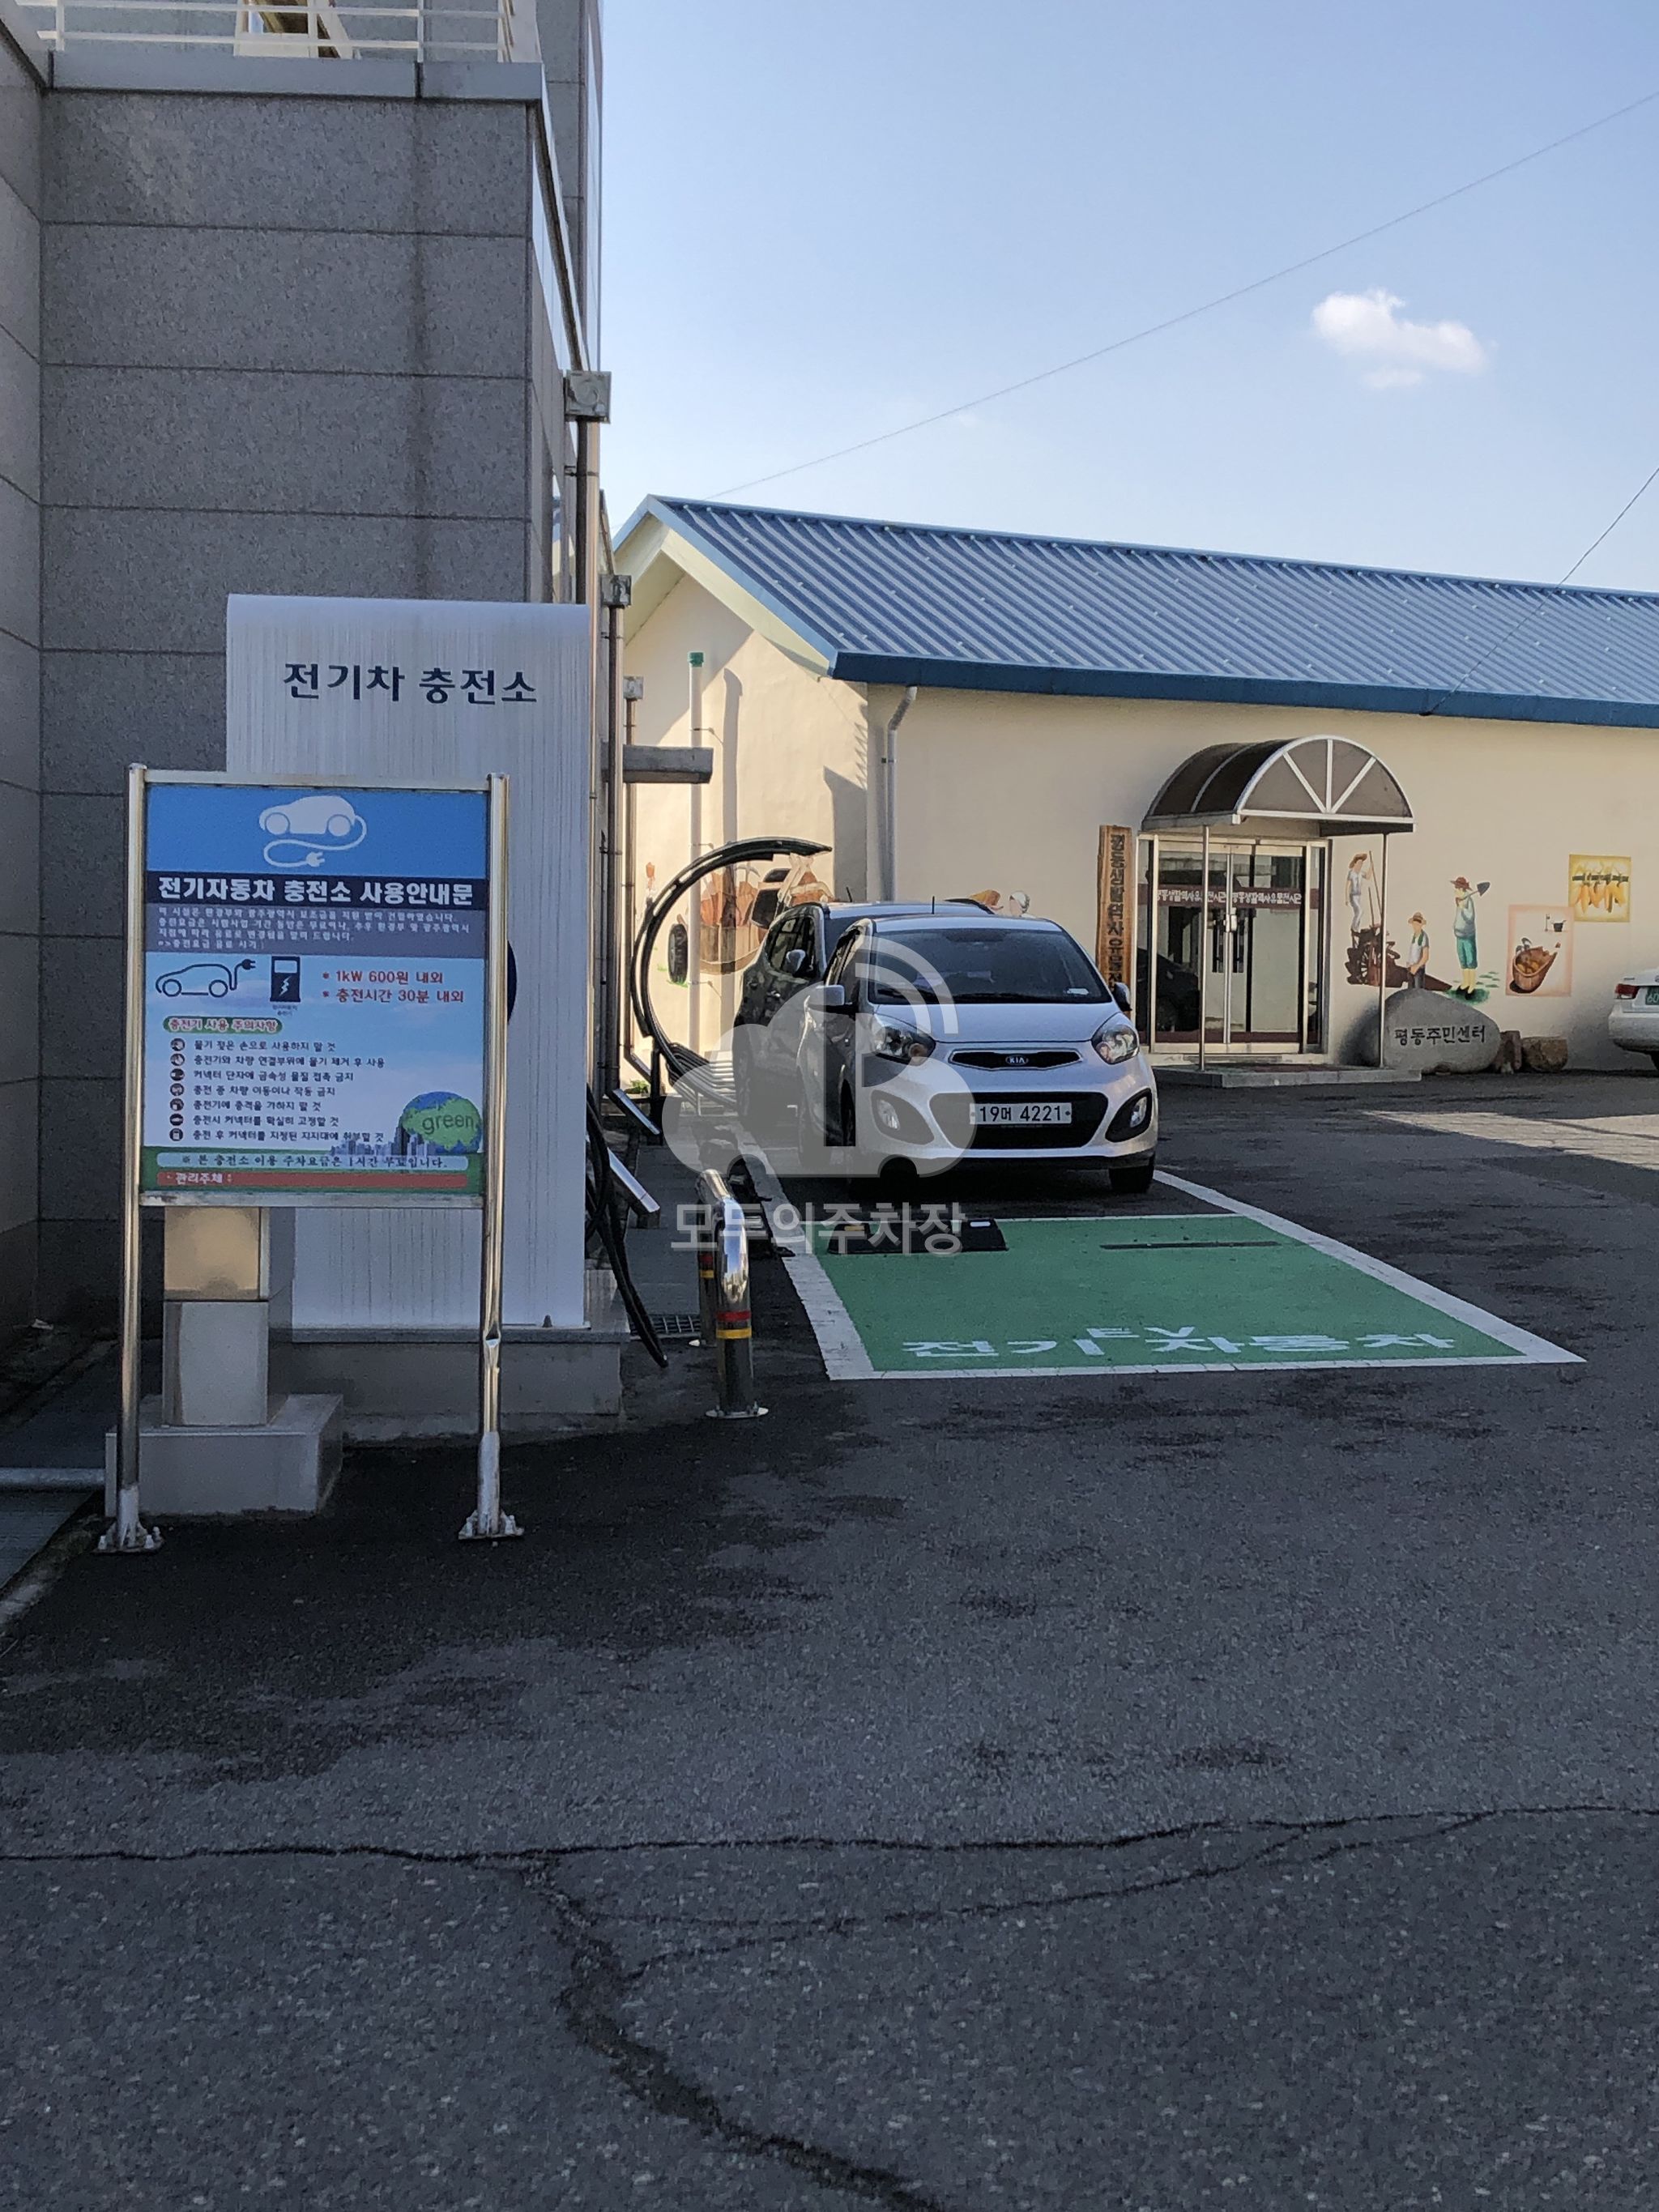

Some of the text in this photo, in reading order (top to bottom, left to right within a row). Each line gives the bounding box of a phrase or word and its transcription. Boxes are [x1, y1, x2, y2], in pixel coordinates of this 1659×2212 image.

[283, 663, 537, 705] 전기차 충전소
[158, 876, 473, 906] 전기자동차 충전소 사용안내문
[335, 970, 443, 985] 1kW 600원 내외
[335, 987, 464, 1004] 충전시간 30분 내외
[169, 1017, 278, 1033] 충전기 사용 주의사항
[1394, 1025, 1486, 1046] 평동주민센터
[239, 1041, 267, 1051] 손으로
[271, 1041, 309, 1052] 사용하지
[327, 1042, 336, 1052] 것
[194, 1055, 231, 1066] 충전기와
[236, 1055, 254, 1066] 차량
[258, 1056, 305, 1068] 연결부위에
[331, 1057, 349, 1067] 제거
[354, 1058, 362, 1067] 후
[366, 1058, 385, 1068] 사용
[1008, 1055, 1027, 1064] KIA
[194, 1070, 222, 1080] 커넥터
[226, 1071, 254, 1080] 단자에
[335, 1072, 353, 1082] 금지
[194, 1085, 212, 1096] 충전
[229, 1085, 249, 1096] 차량
[253, 1086, 290, 1097] 이동이나
[317, 1087, 335, 1097] 금지
[194, 1100, 231, 1111] 충전기에
[235, 1100, 262, 1111] 충격을
[267, 1101, 295, 1110] 가하지
[313, 1102, 321, 1112] 것
[193, 1115, 339, 1127] 충전시 커넥터를 확실히 고정할 것
[979, 1106, 1061, 1123] 19머 4221
[422, 1113, 474, 1135] green
[193, 1130, 211, 1140] 충전
[215, 1131, 224, 1140] 후
[228, 1131, 266, 1141] 커넥터를
[270, 1131, 297, 1141] 지정된
[375, 1132, 384, 1143] 것
[215, 1155, 249, 1166] 충전소
[254, 1155, 278, 1166] 이용
[283, 1156, 343, 1167] 주차요금은
[384, 1156, 448, 1169] 무료입니다.
[176, 1172, 223, 1185] 관리주체
[1086, 1327, 1196, 1338] EV
[901, 1333, 1455, 1357] 전기자동차
